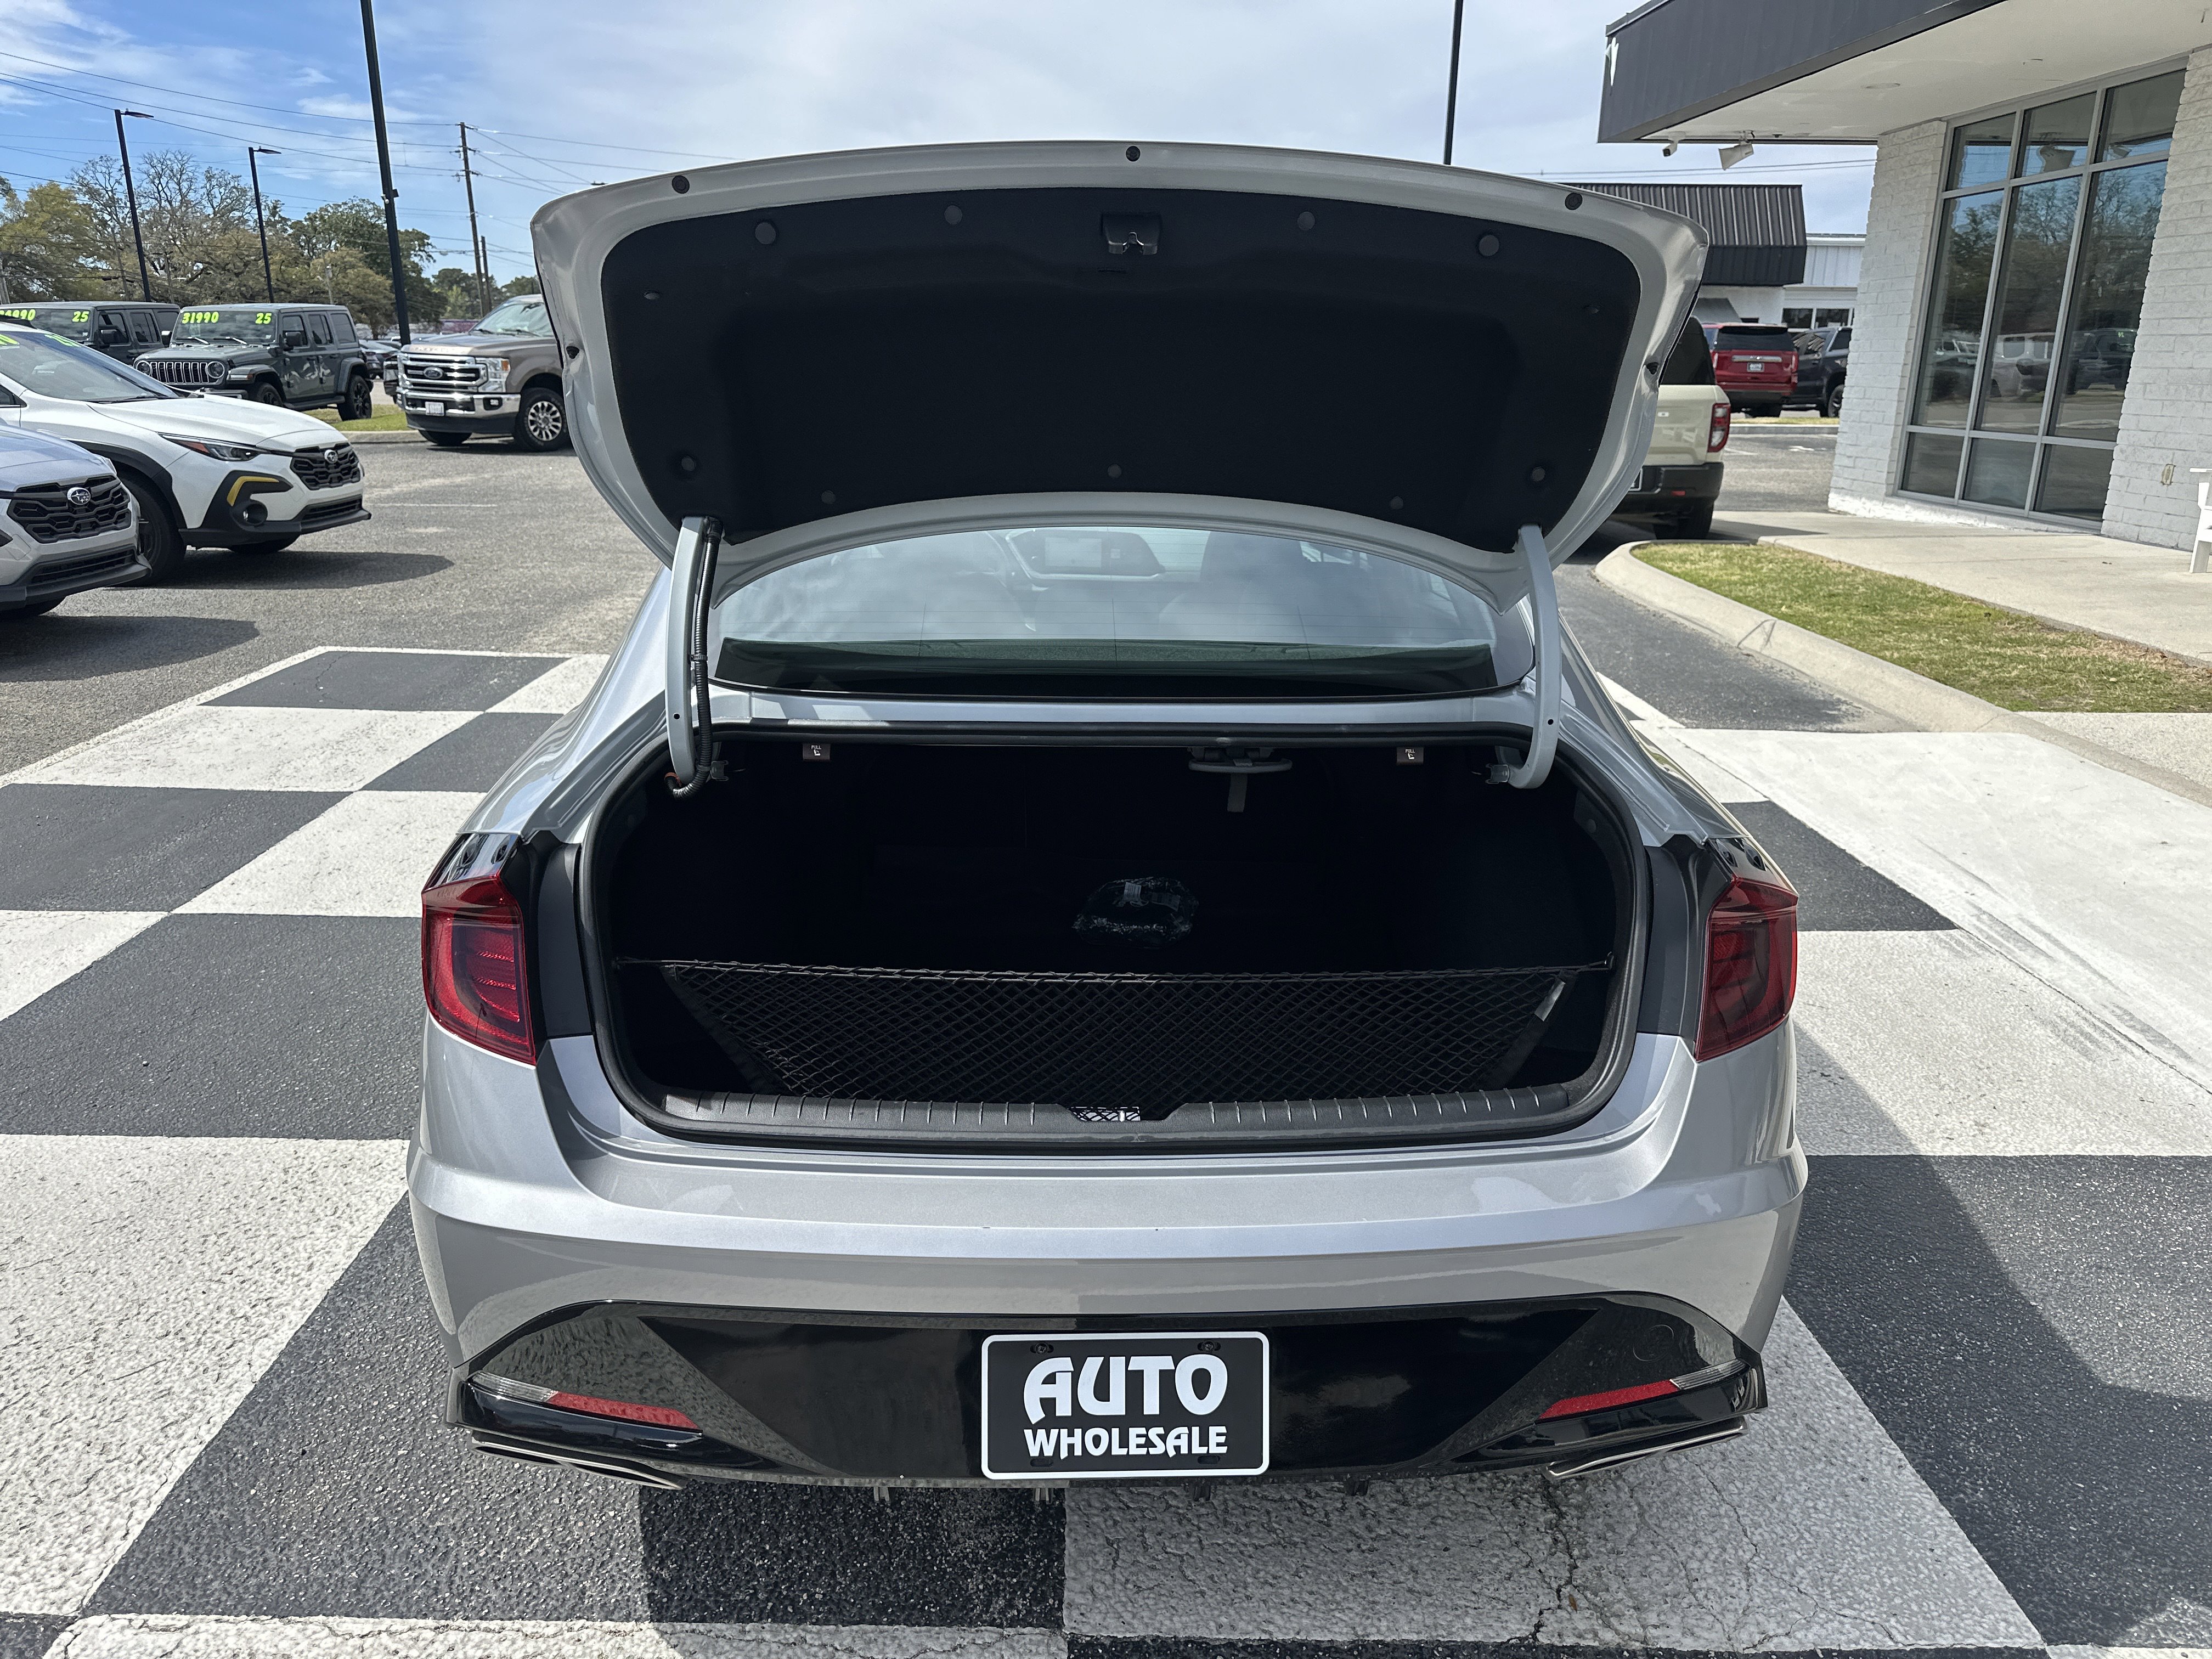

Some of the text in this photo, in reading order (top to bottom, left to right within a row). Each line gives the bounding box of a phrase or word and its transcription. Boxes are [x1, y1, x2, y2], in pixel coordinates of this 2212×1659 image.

[0, 309, 36, 321] 4990
[72, 311, 89, 323] 25
[182, 312, 219, 324] 31990
[255, 312, 272, 324] 25
[1023, 1354, 1228, 1425] AUTO
[1023, 1426, 1228, 1460] WHOLESALE
